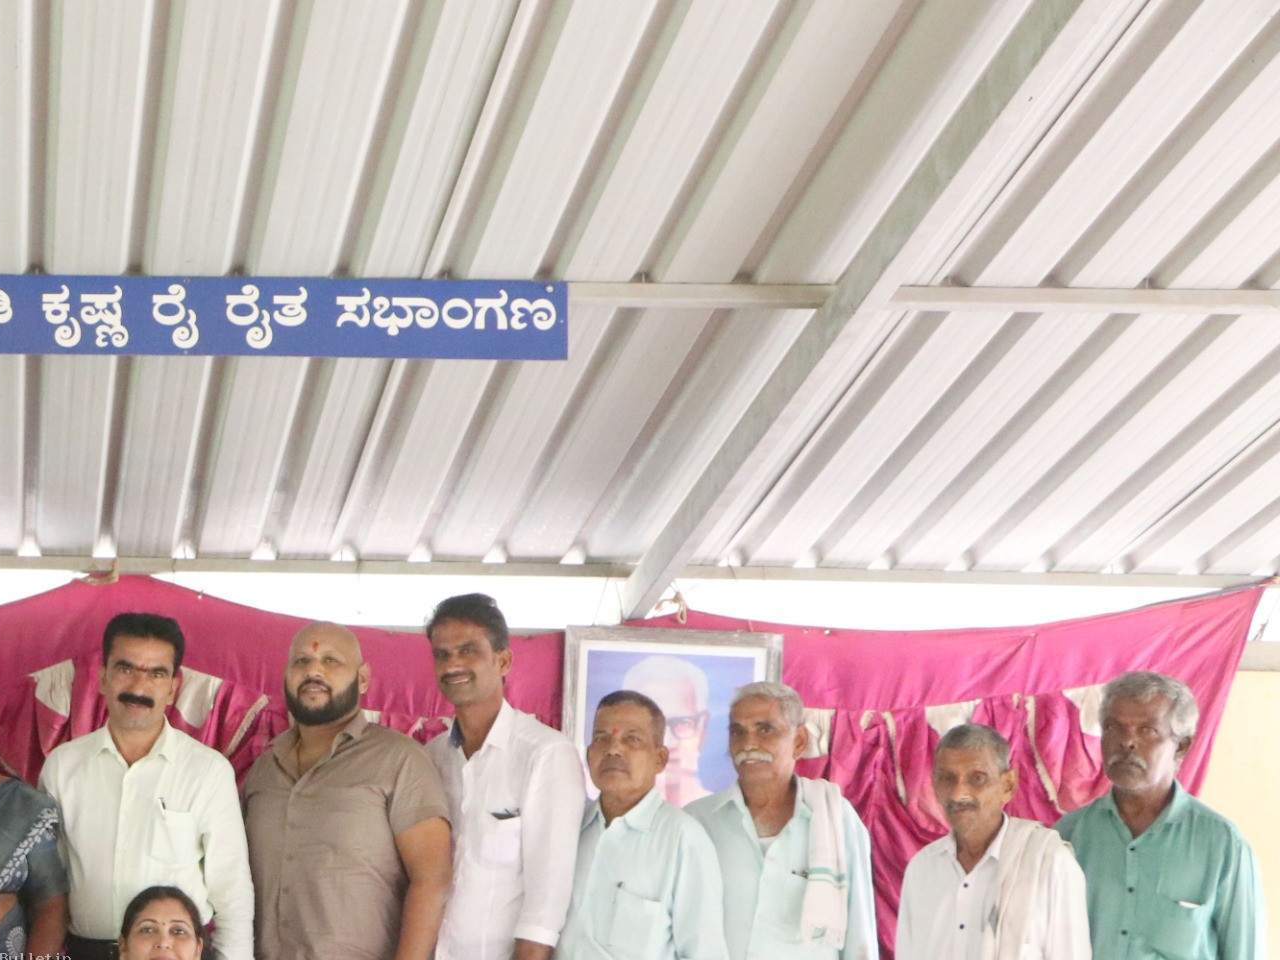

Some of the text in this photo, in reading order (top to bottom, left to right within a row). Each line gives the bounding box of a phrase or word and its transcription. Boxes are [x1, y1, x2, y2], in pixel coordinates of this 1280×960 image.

[42, 284, 129, 348] ಕೃಷ್ಣ
[152, 283, 200, 349] ರೈ
[225, 284, 308, 350] ರೈತ
[335, 287, 557, 336] ಸಭಾಂಗಣ
